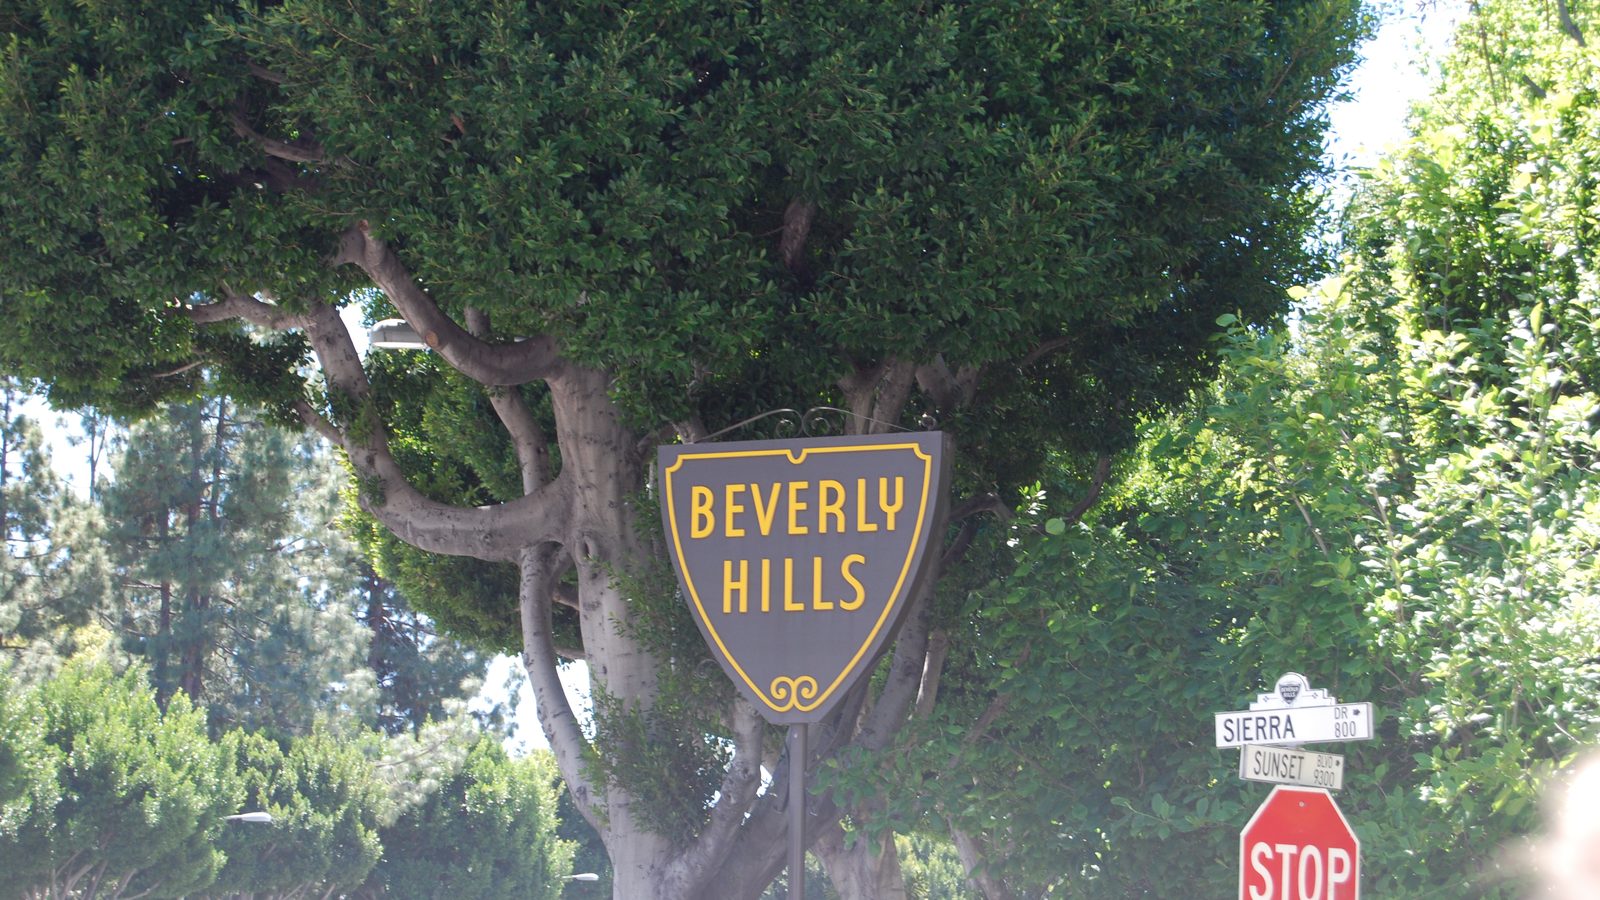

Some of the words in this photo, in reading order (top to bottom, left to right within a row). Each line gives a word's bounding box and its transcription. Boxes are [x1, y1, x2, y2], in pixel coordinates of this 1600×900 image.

[691, 476, 904, 539] BEVERLY
[723, 553, 866, 613] HILLS
[1334, 706, 1348, 720] DR
[1223, 714, 1296, 743] SIERRA
[1334, 720, 1357, 738] 800
[1253, 750, 1305, 780] SUNSET
[1316, 754, 1333, 769] BLVD
[1313, 768, 1335, 787] 9300
[1248, 841, 1351, 900] STOP
